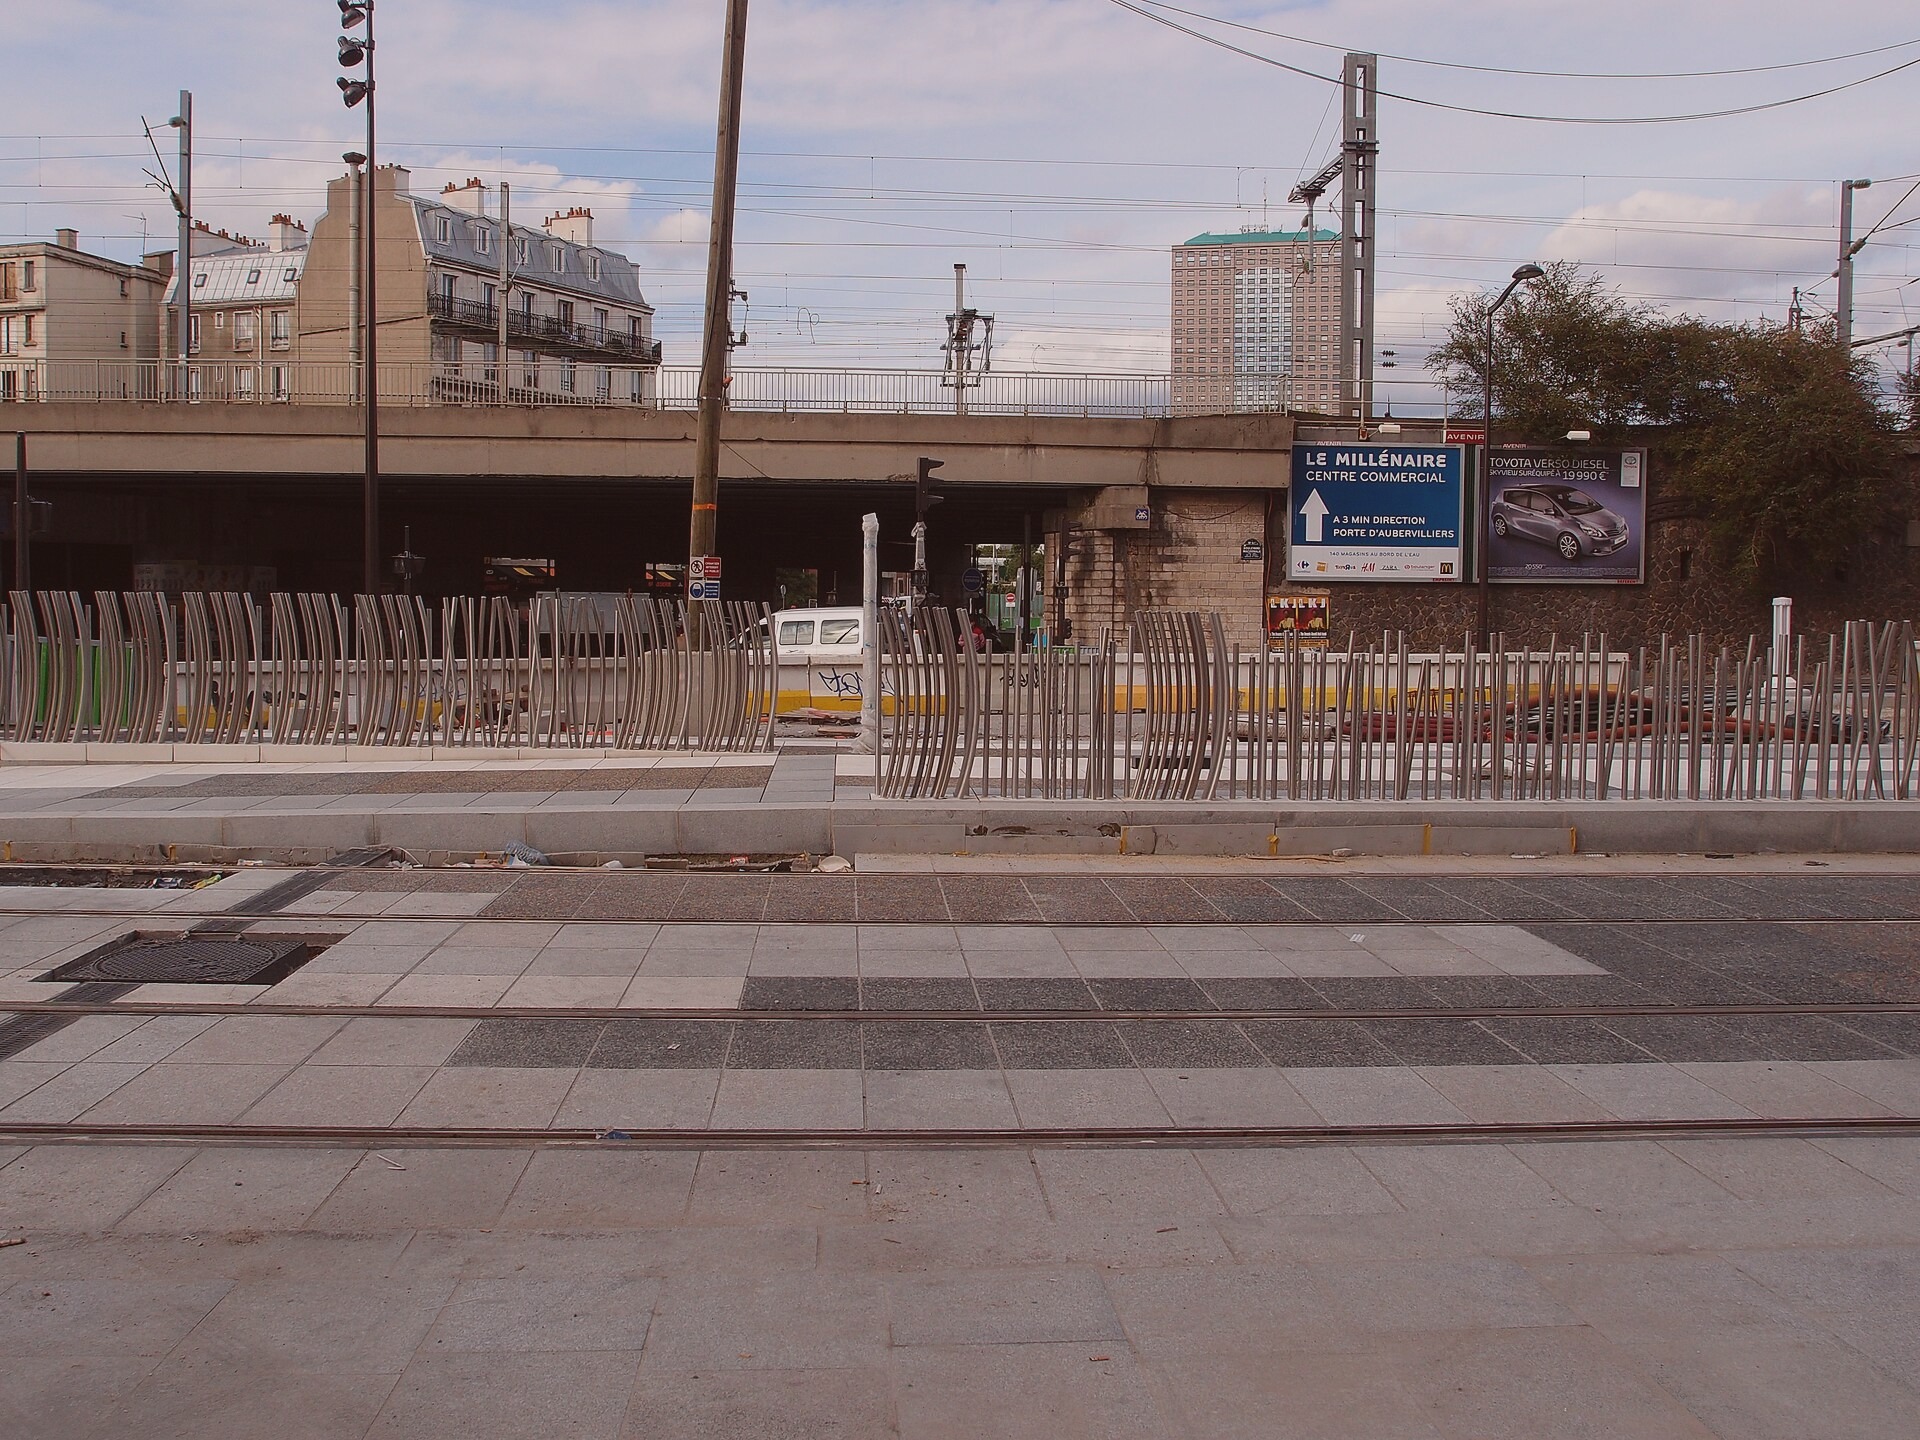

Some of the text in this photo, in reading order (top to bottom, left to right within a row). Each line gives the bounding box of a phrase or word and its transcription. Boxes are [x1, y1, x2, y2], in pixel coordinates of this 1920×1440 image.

[1446, 433, 1484, 441] AVENIR
[1306, 449, 1447, 468] LE MILLÉNAIRE
[1489, 457, 1610, 470] TOYOTA VERSO DIESEL
[1306, 470, 1446, 483] CENTRE COMMERCIAL
[1333, 516, 1426, 525] A 3 MIN DIRECTION
[1333, 529, 1455, 538] PORTE D'AUBERVILLIERS
